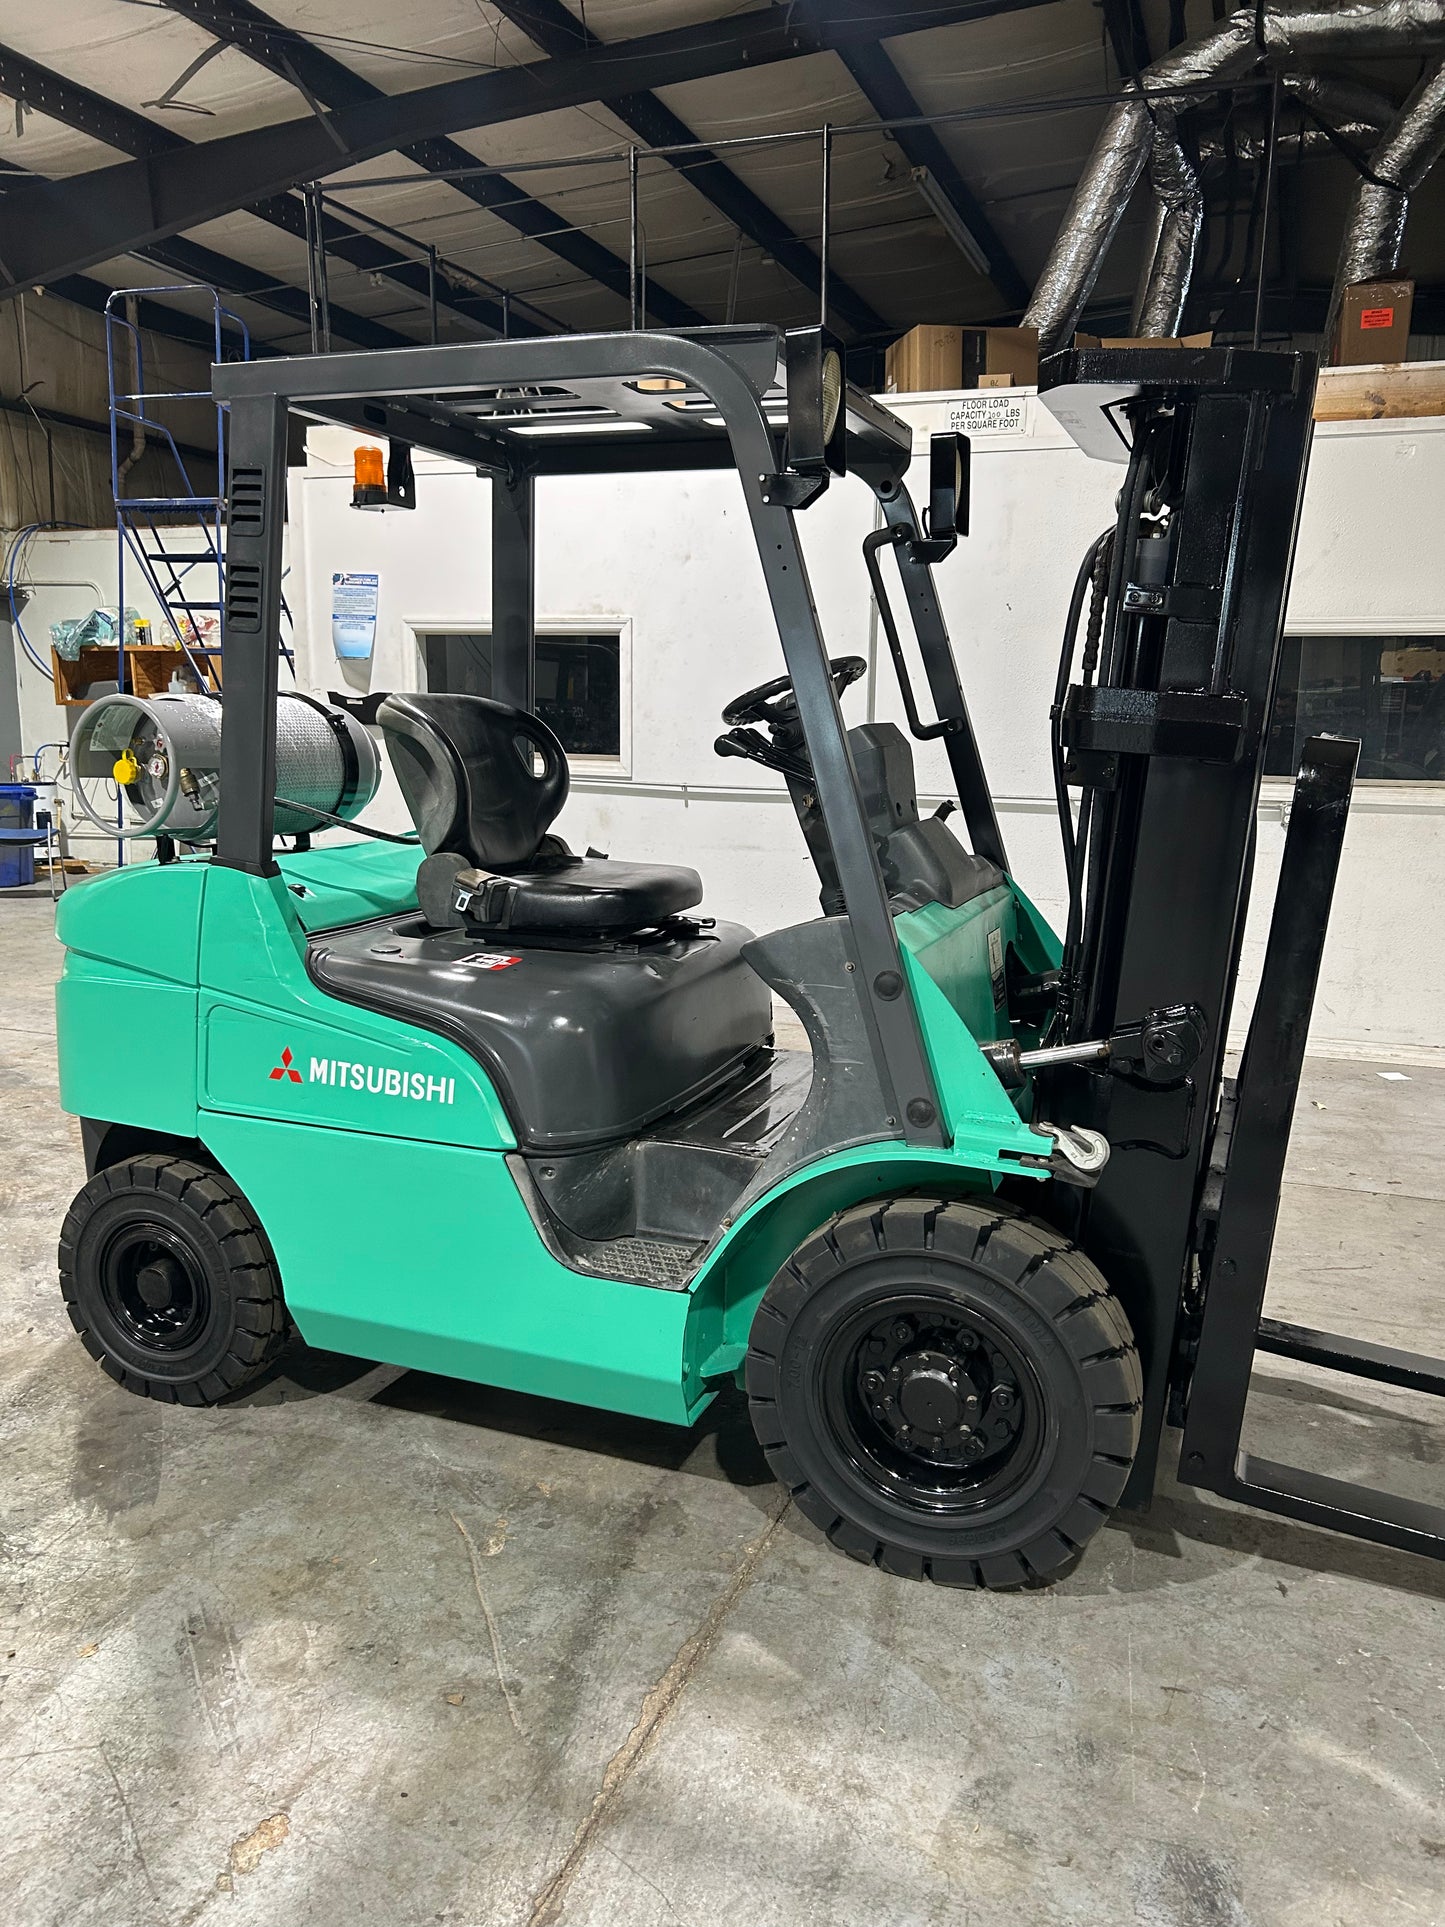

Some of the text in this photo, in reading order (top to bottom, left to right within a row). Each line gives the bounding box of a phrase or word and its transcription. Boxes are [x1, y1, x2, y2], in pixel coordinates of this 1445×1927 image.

[962, 399, 1009, 409] FLOOR LOAD
[951, 410, 986, 420] CAPACITY
[1006, 409, 1020, 417] LBS
[951, 419, 1019, 429] PER SQUARE FOOT
[309, 1056, 455, 1105] MITSUBISHI
